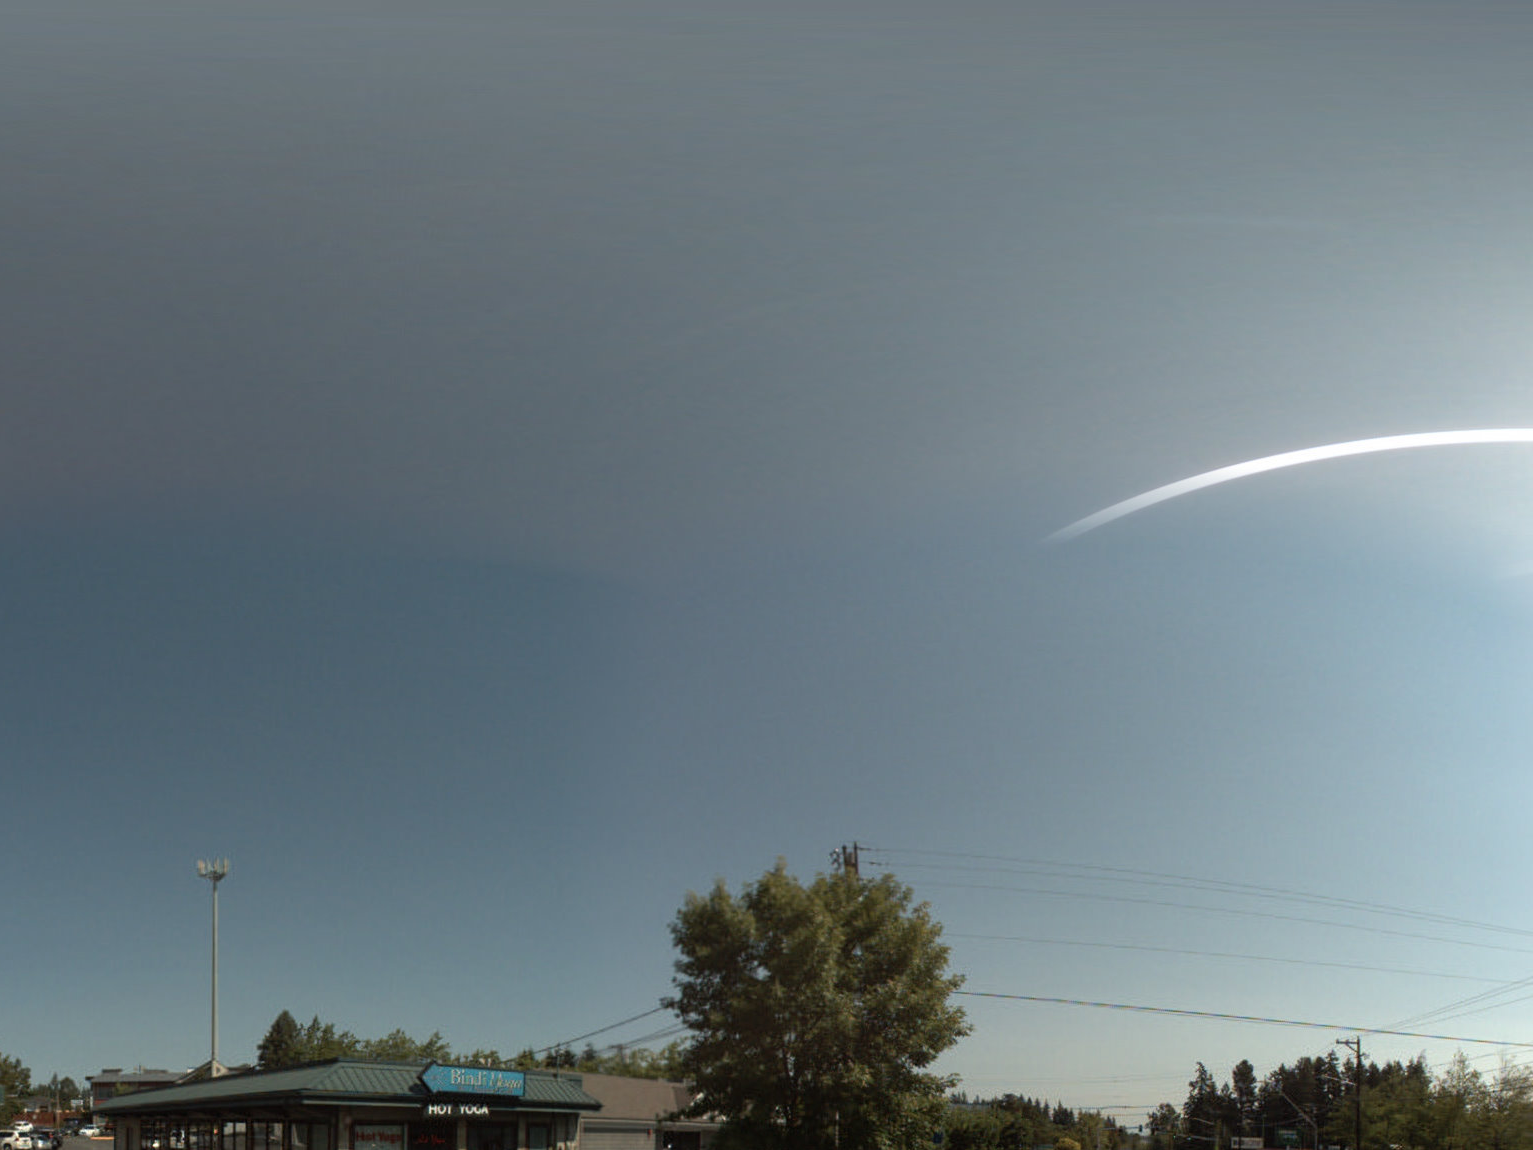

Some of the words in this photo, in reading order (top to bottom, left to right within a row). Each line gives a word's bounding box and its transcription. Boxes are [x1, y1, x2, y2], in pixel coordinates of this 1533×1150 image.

[450, 1068, 487, 1086] Bindi
[428, 1104, 452, 1115] HOT
[458, 1104, 489, 1115] YOGA
